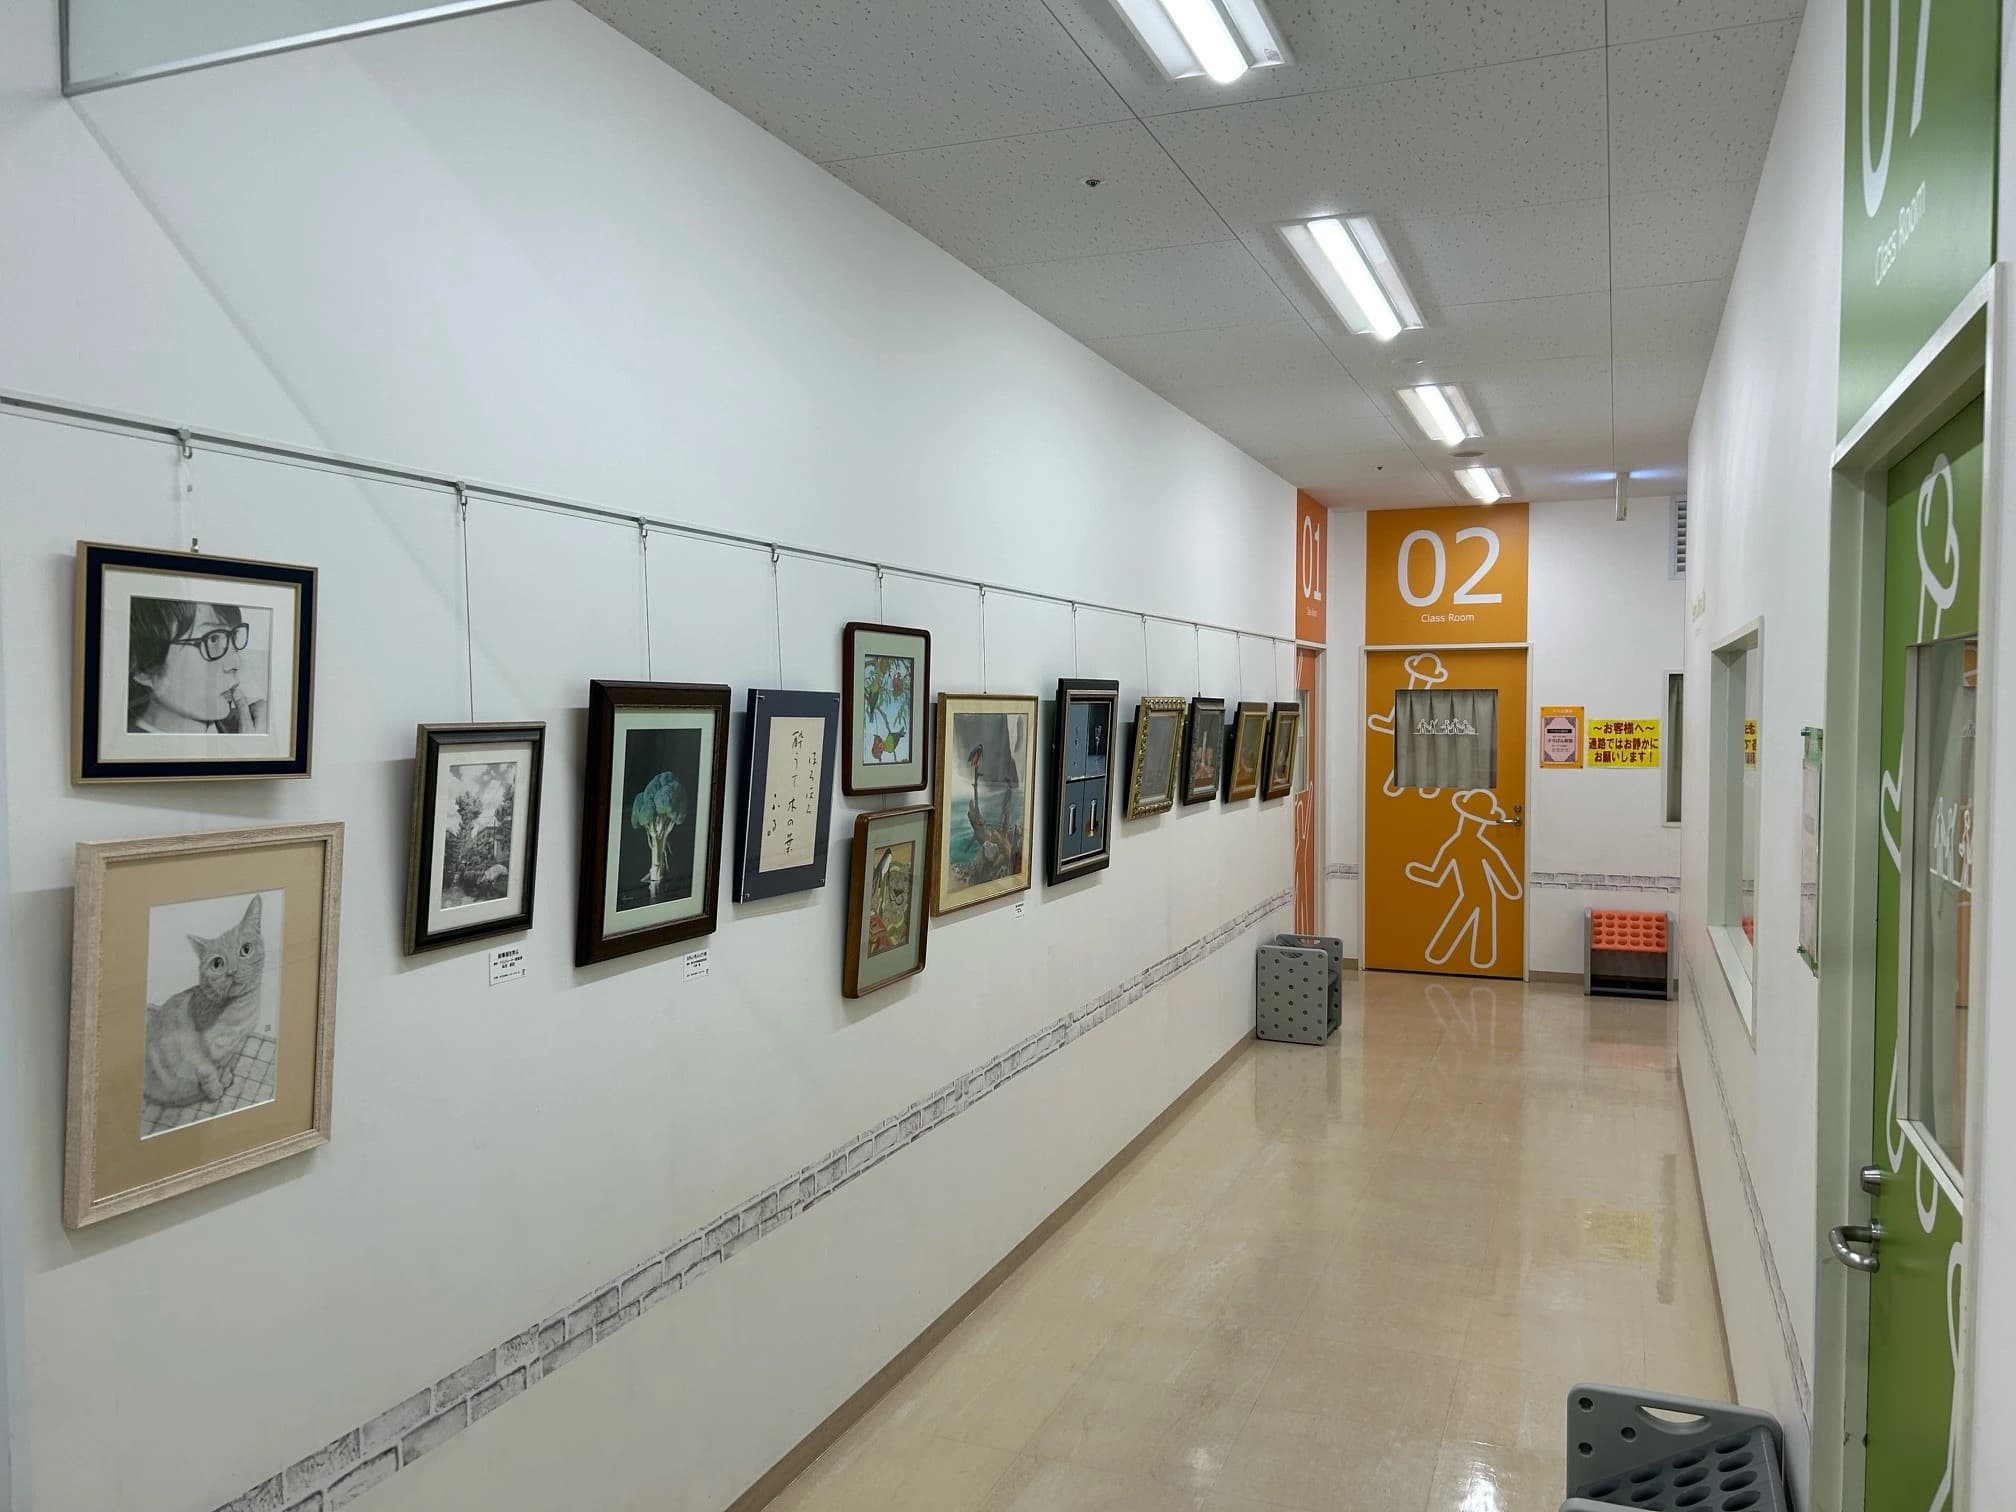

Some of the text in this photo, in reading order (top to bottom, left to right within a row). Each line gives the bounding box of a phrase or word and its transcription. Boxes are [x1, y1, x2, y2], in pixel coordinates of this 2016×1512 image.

[1302, 515, 1322, 600] 01
[1397, 526, 1503, 607] 02
[1421, 613, 1475, 623] Class Room
[1589, 737, 1659, 750] 通路ではお静かに
